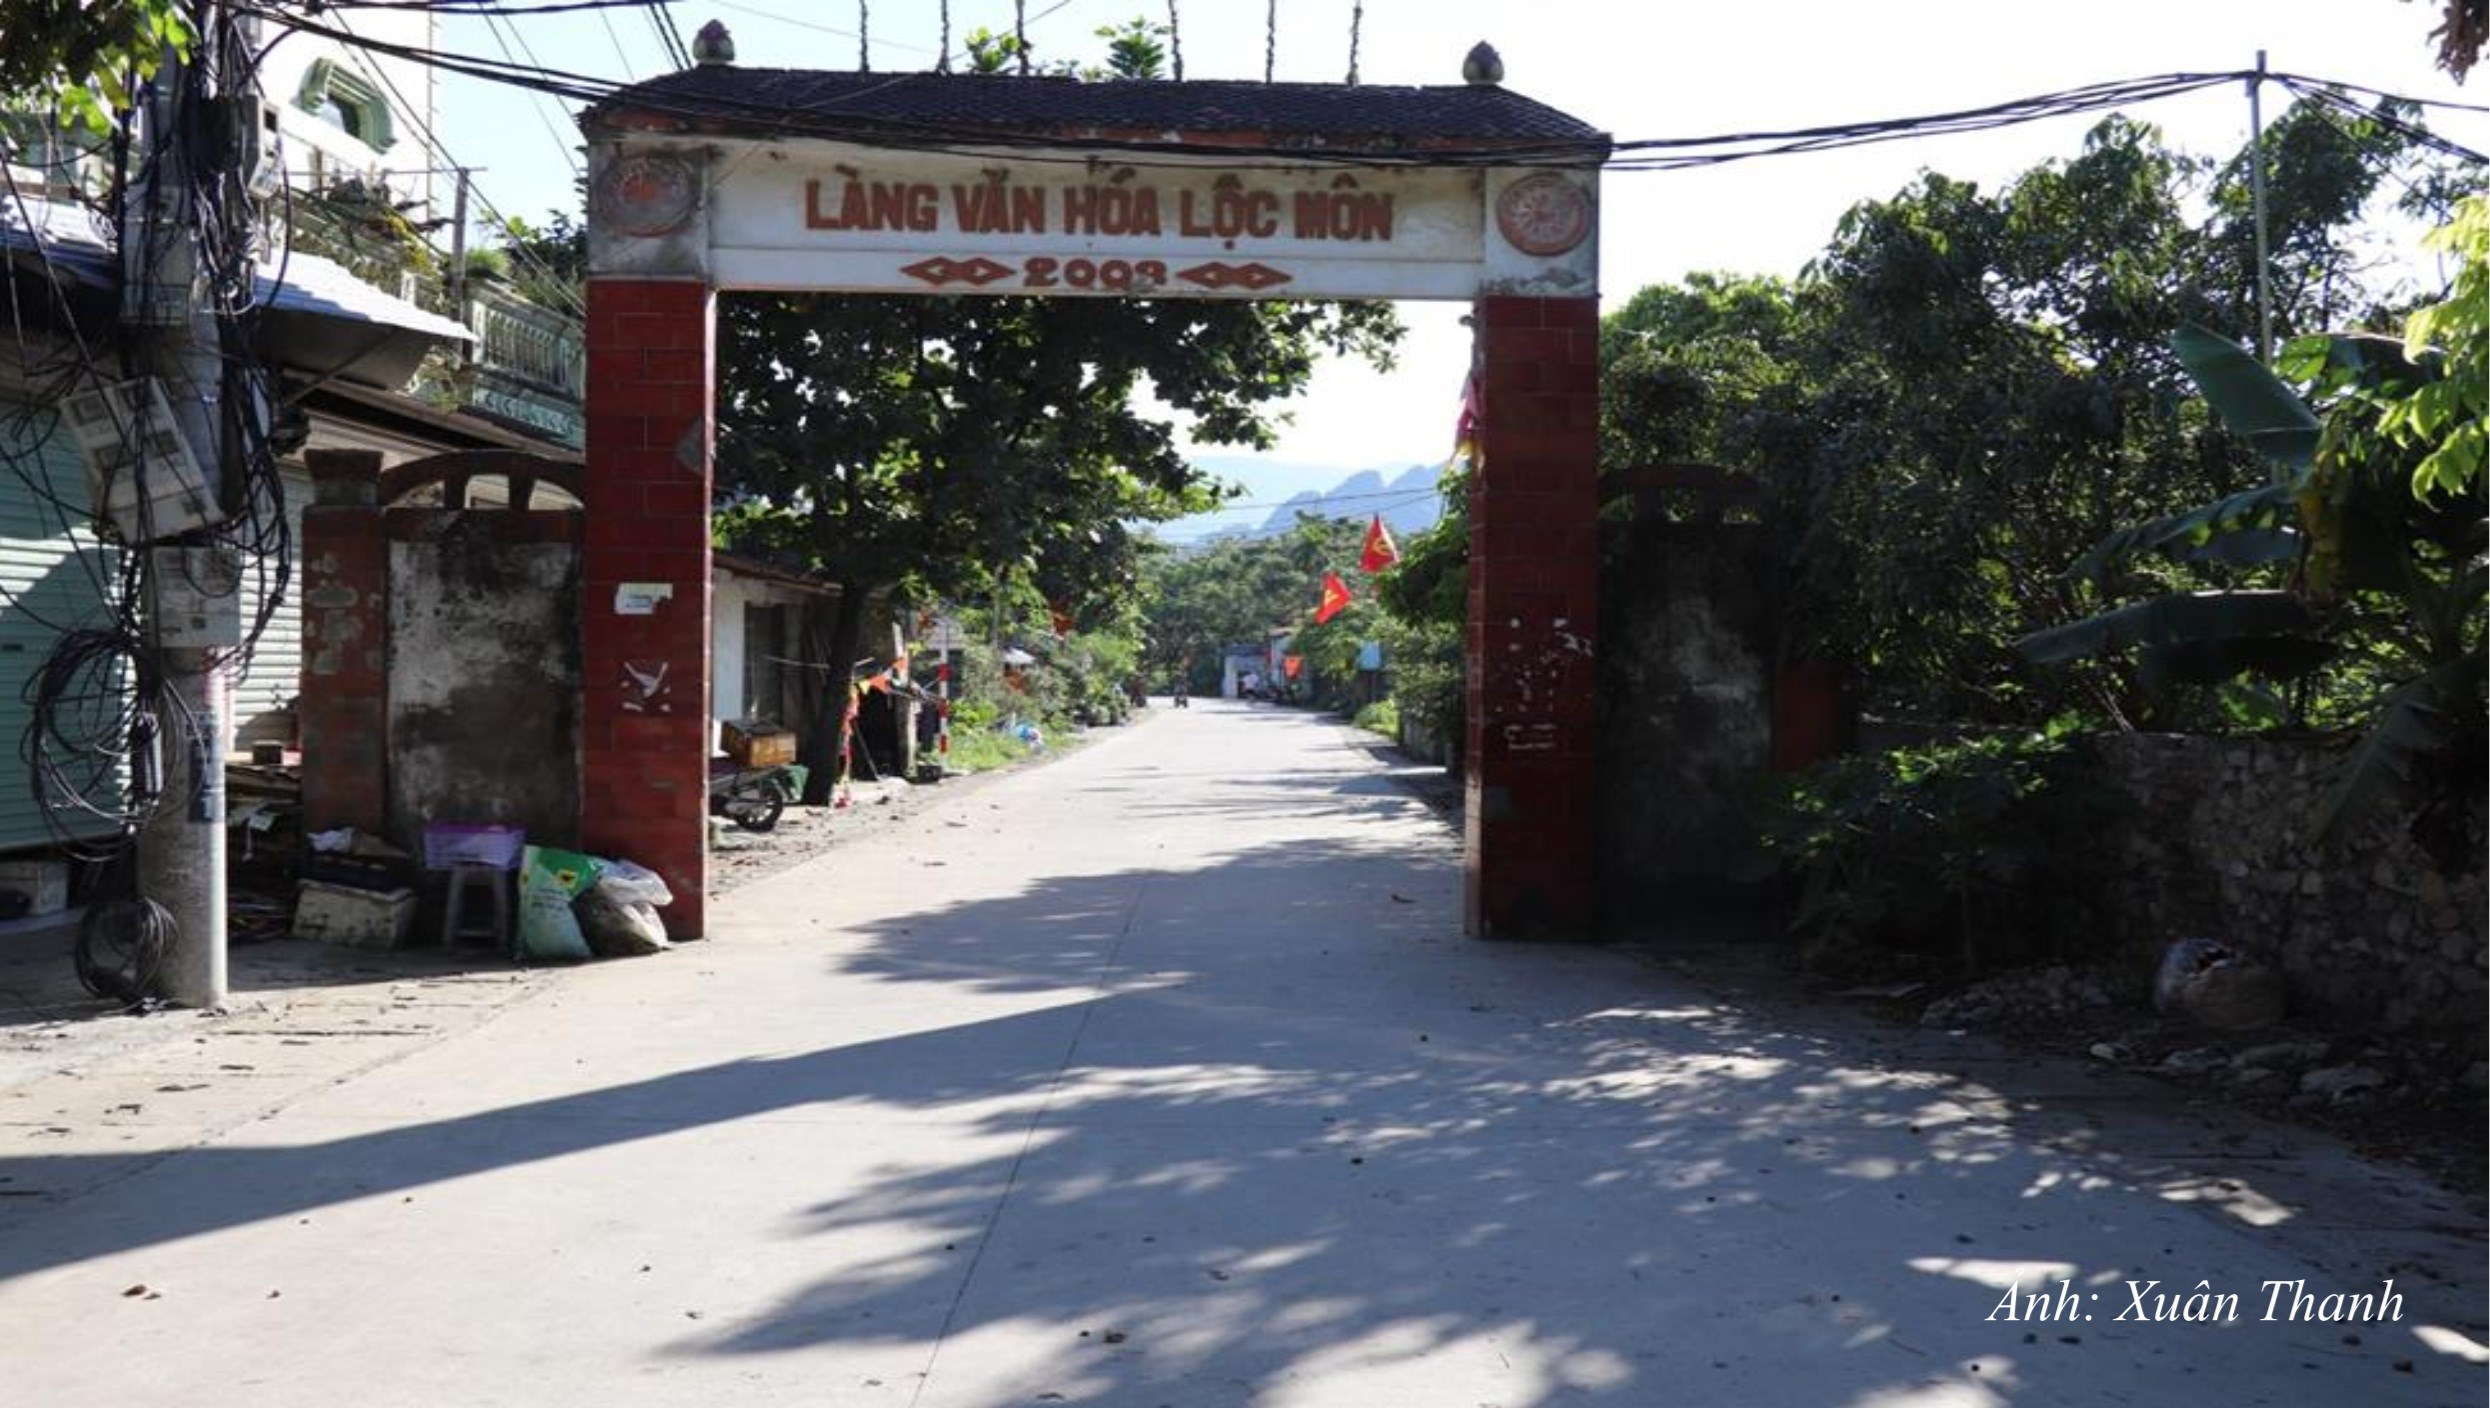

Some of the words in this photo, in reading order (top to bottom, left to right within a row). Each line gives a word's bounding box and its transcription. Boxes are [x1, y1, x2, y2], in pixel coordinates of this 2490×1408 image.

[806, 164, 940, 233] LÀNG
[951, 166, 1046, 235] VĂN
[1063, 166, 1161, 236] HÓA
[1179, 173, 1280, 250] LỘC
[1294, 172, 1394, 241] MÔN
